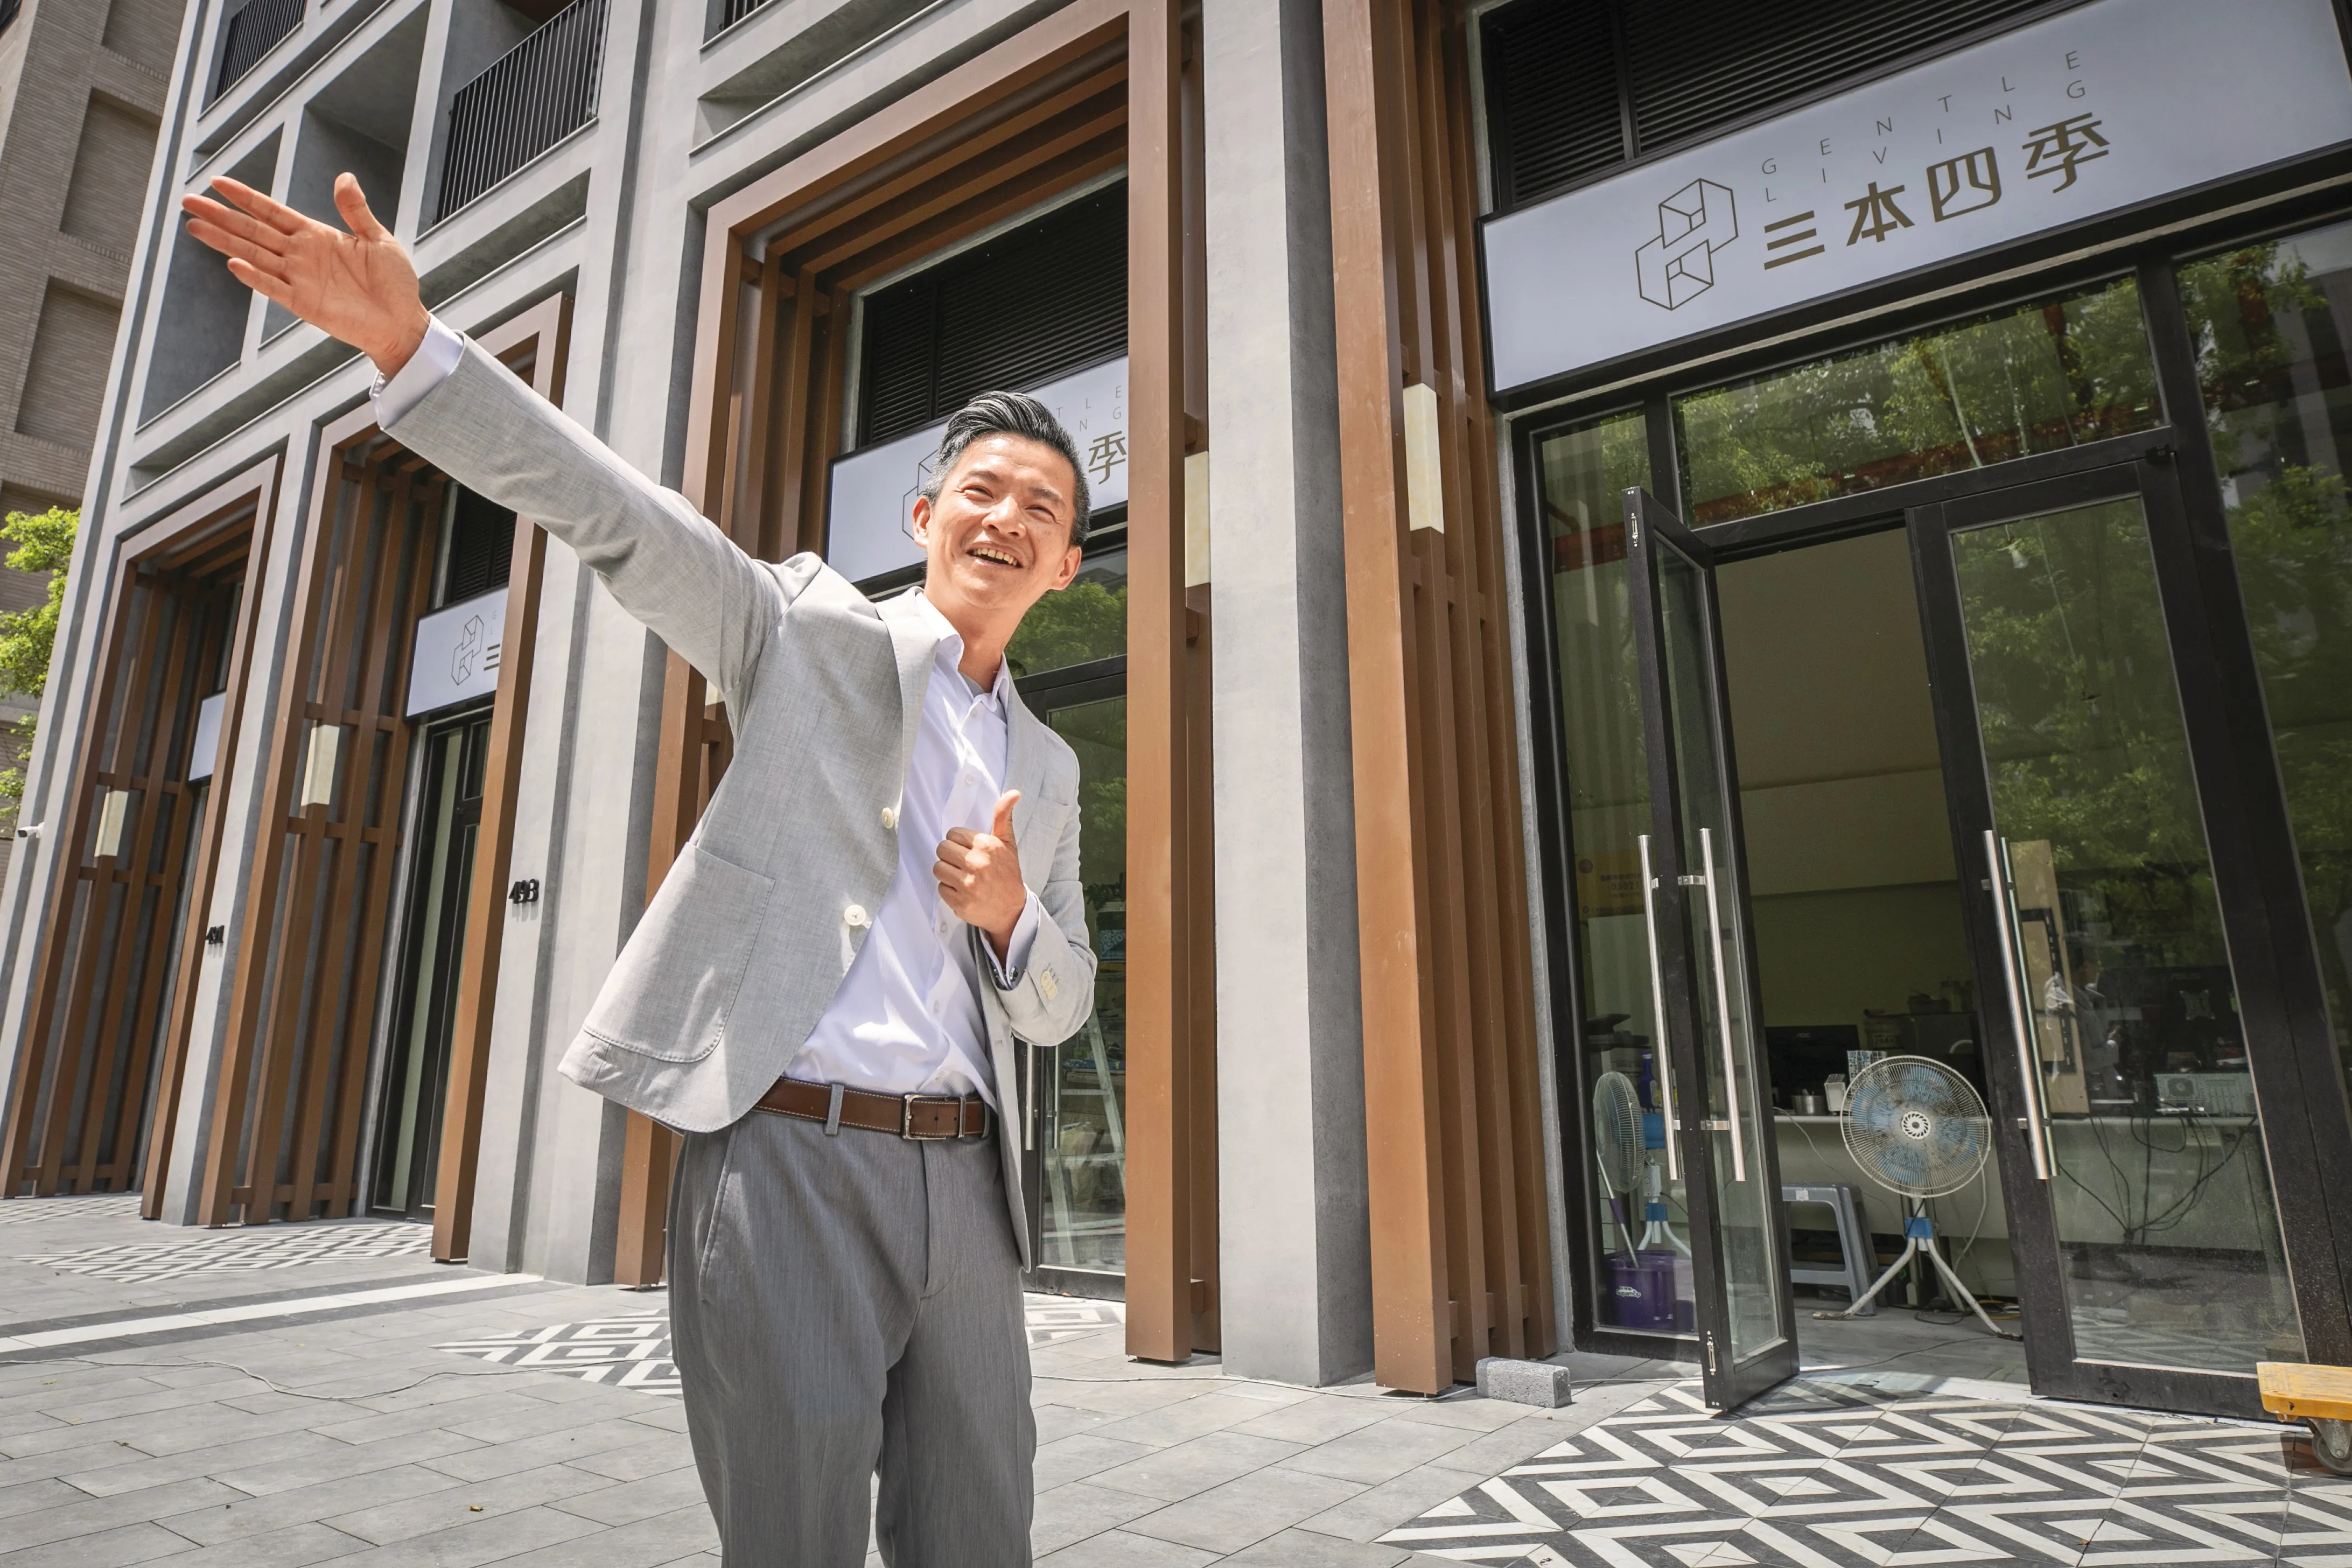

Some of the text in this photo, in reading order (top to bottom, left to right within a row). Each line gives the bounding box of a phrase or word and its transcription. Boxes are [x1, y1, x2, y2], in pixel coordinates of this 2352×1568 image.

[1761, 51, 2080, 175] GENTLE
[1766, 80, 2085, 202] LIVING
[1763, 111, 2111, 271] 三本四季
